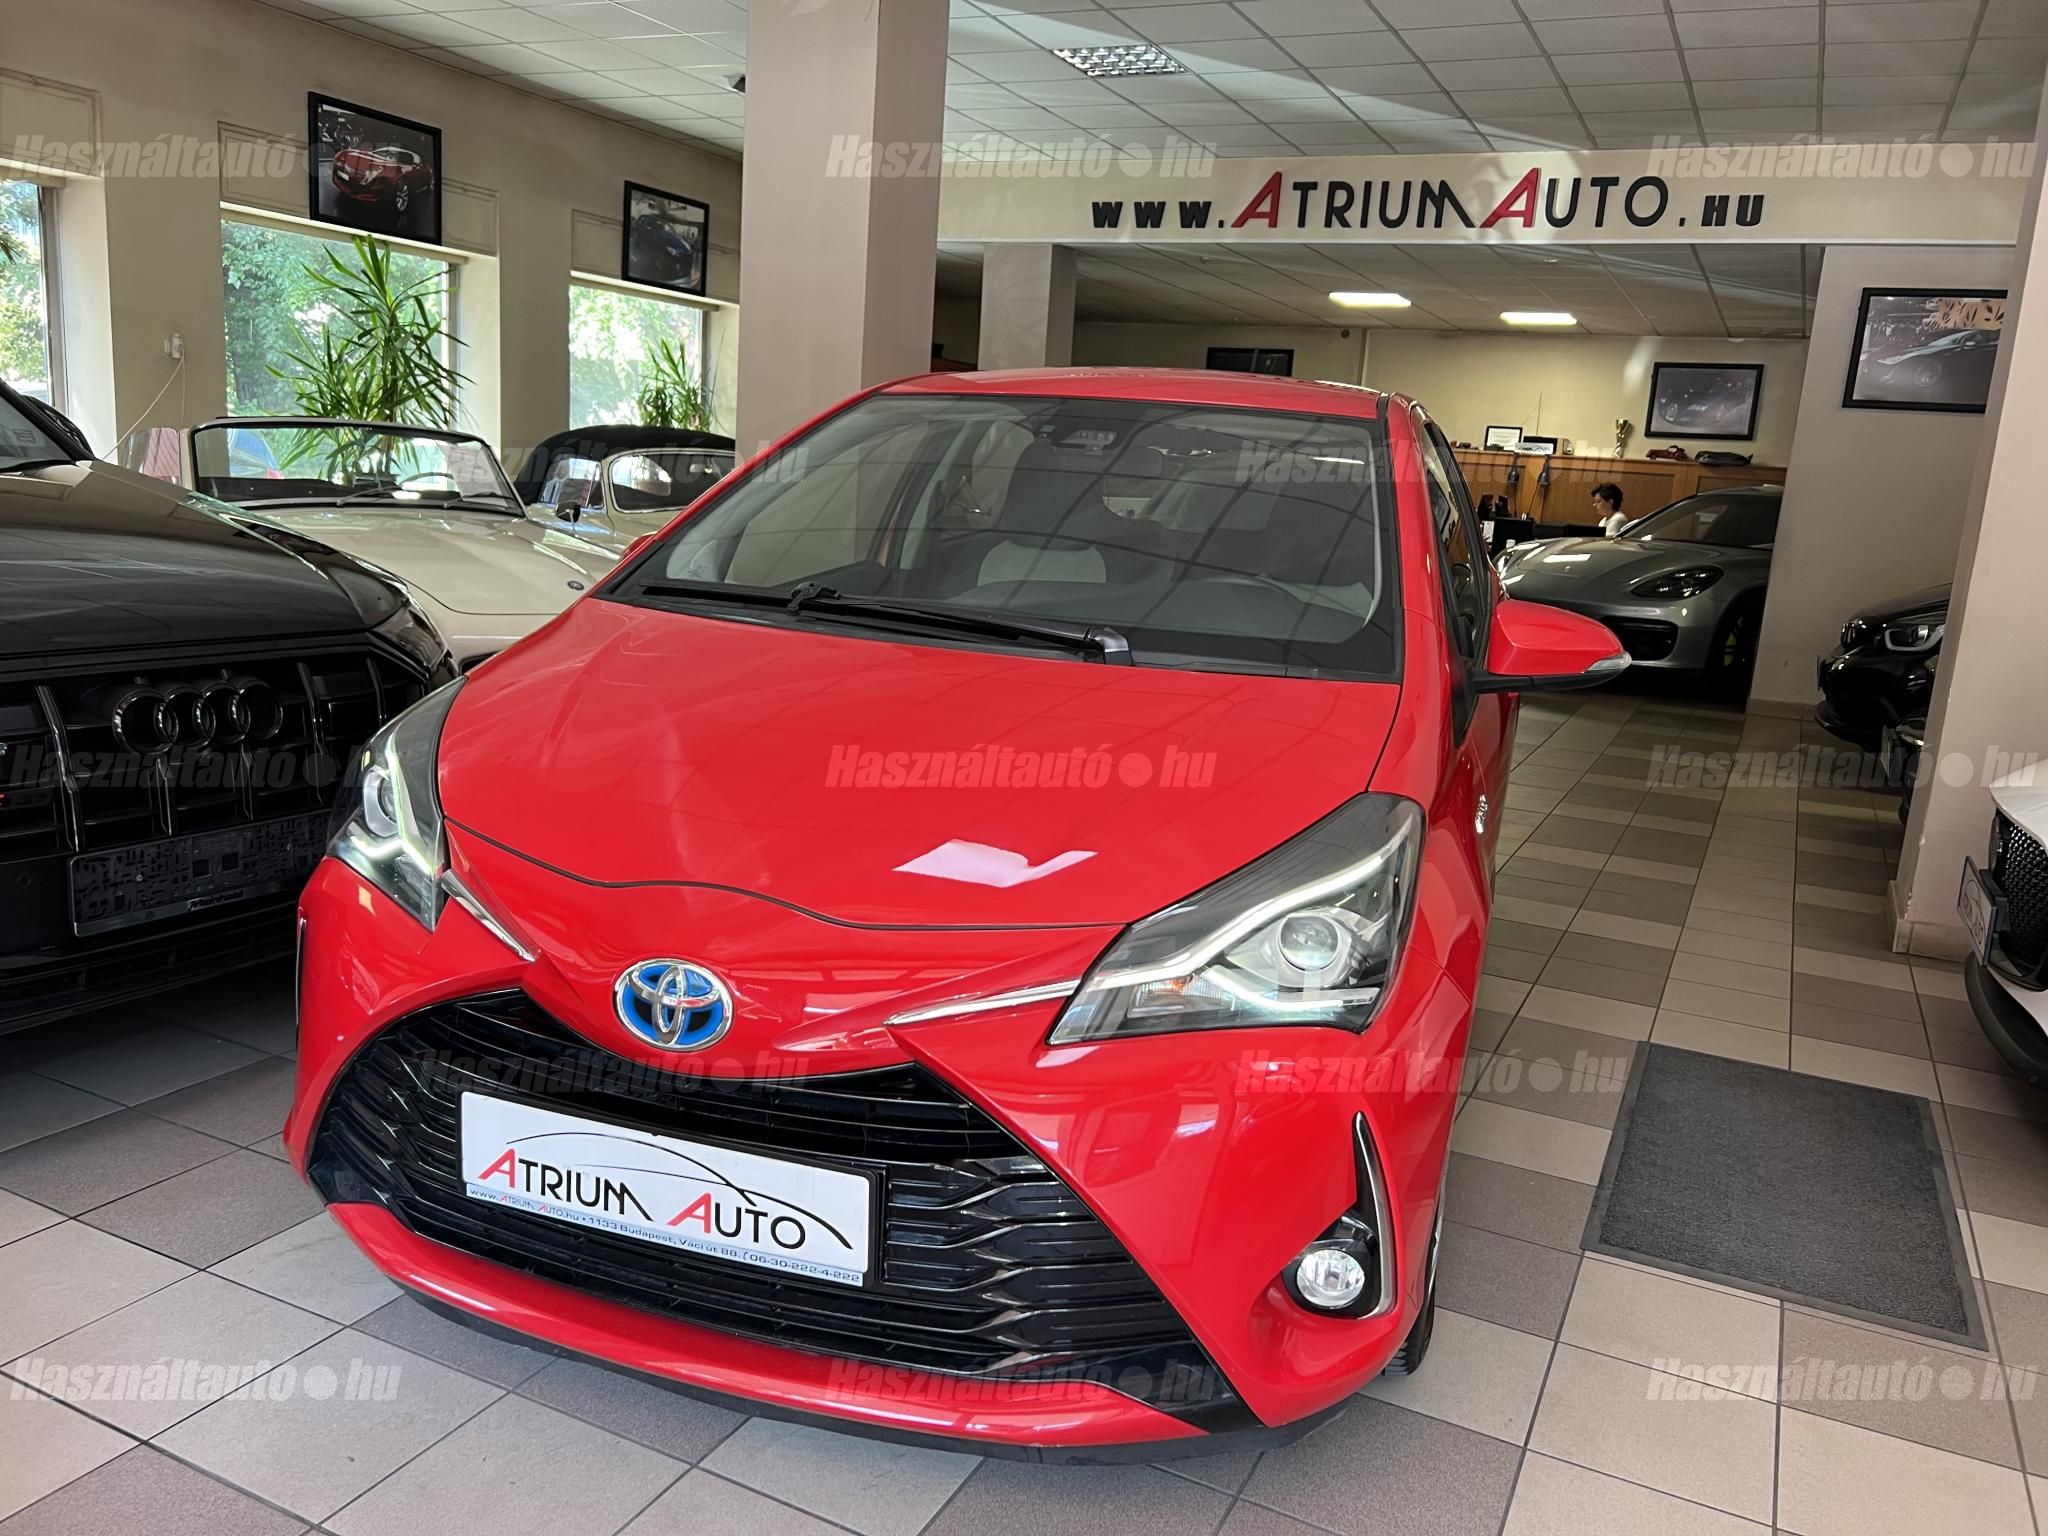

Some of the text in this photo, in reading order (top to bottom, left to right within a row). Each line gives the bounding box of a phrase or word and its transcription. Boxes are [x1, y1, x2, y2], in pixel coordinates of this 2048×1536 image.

[478, 1148, 806, 1250] ATRIUM AUTO
[590, 1217, 618, 1231] 1133
